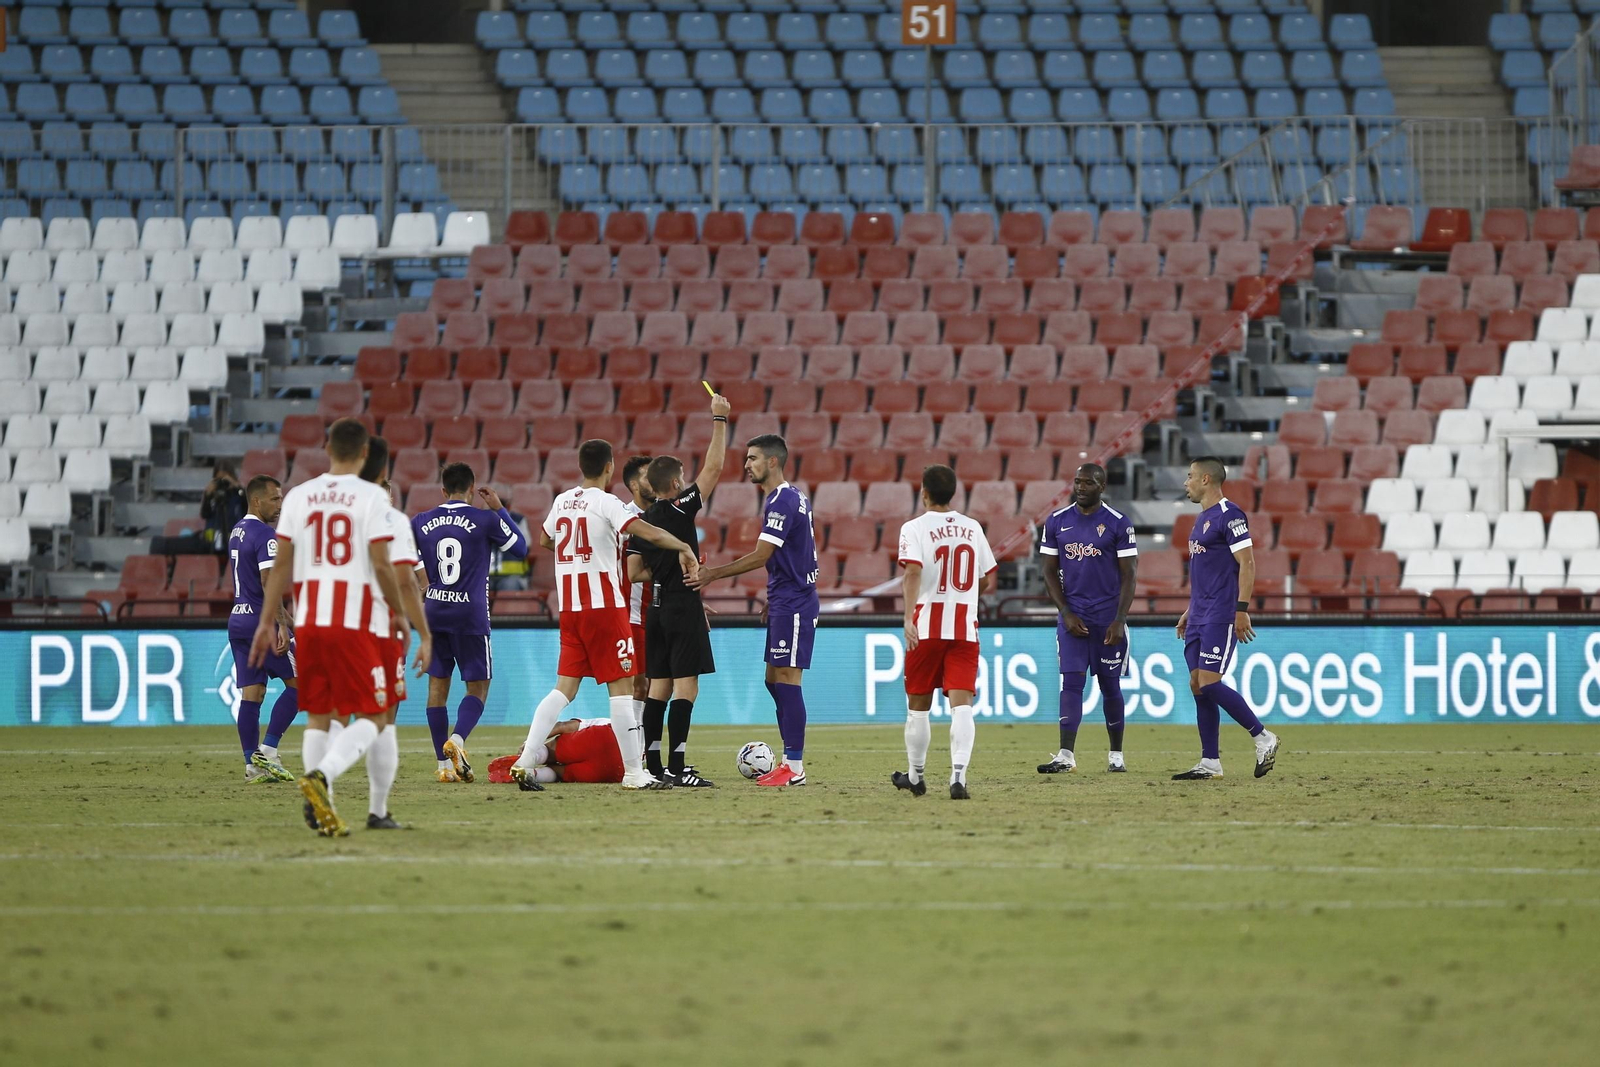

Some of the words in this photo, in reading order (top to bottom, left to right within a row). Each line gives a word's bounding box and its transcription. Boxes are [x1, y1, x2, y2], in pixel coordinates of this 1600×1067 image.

[909, 4, 946, 38] 51
[304, 510, 352, 567] 18
[421, 515, 452, 535] PEDRO
[453, 515, 477, 533] DÍAZ
[555, 516, 593, 564] 24
[929, 525, 974, 543] AKETXE
[231, 549, 240, 597] 7
[437, 537, 462, 585] 8
[934, 543, 975, 594] 10
[616, 637, 634, 658] 24
[30, 634, 184, 722] PDR
[1221, 642, 1384, 718] oses
[1404, 632, 1557, 718] Hotel
